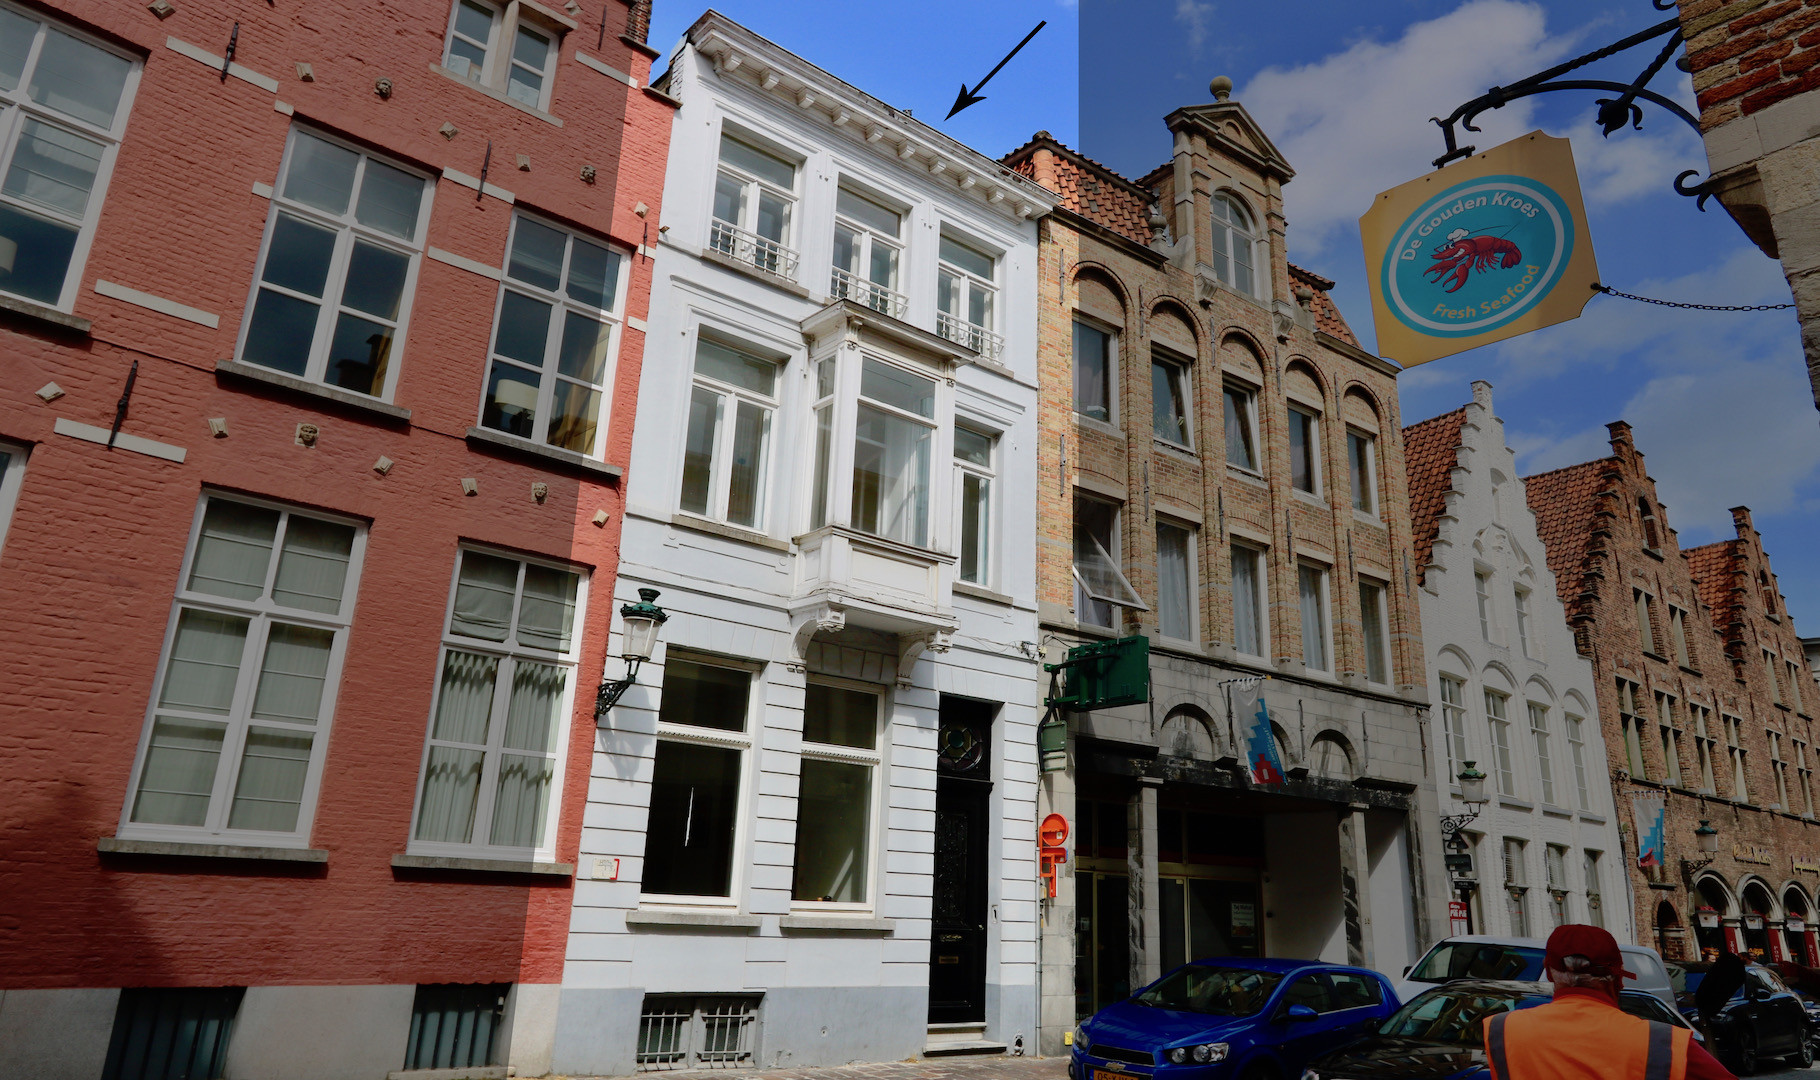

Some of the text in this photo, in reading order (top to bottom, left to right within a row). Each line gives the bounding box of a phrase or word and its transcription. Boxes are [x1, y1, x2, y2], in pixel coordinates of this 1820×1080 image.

[1401, 191, 1540, 261] De Gouden Kroes
[1432, 264, 1540, 319] Fresh Seafood
